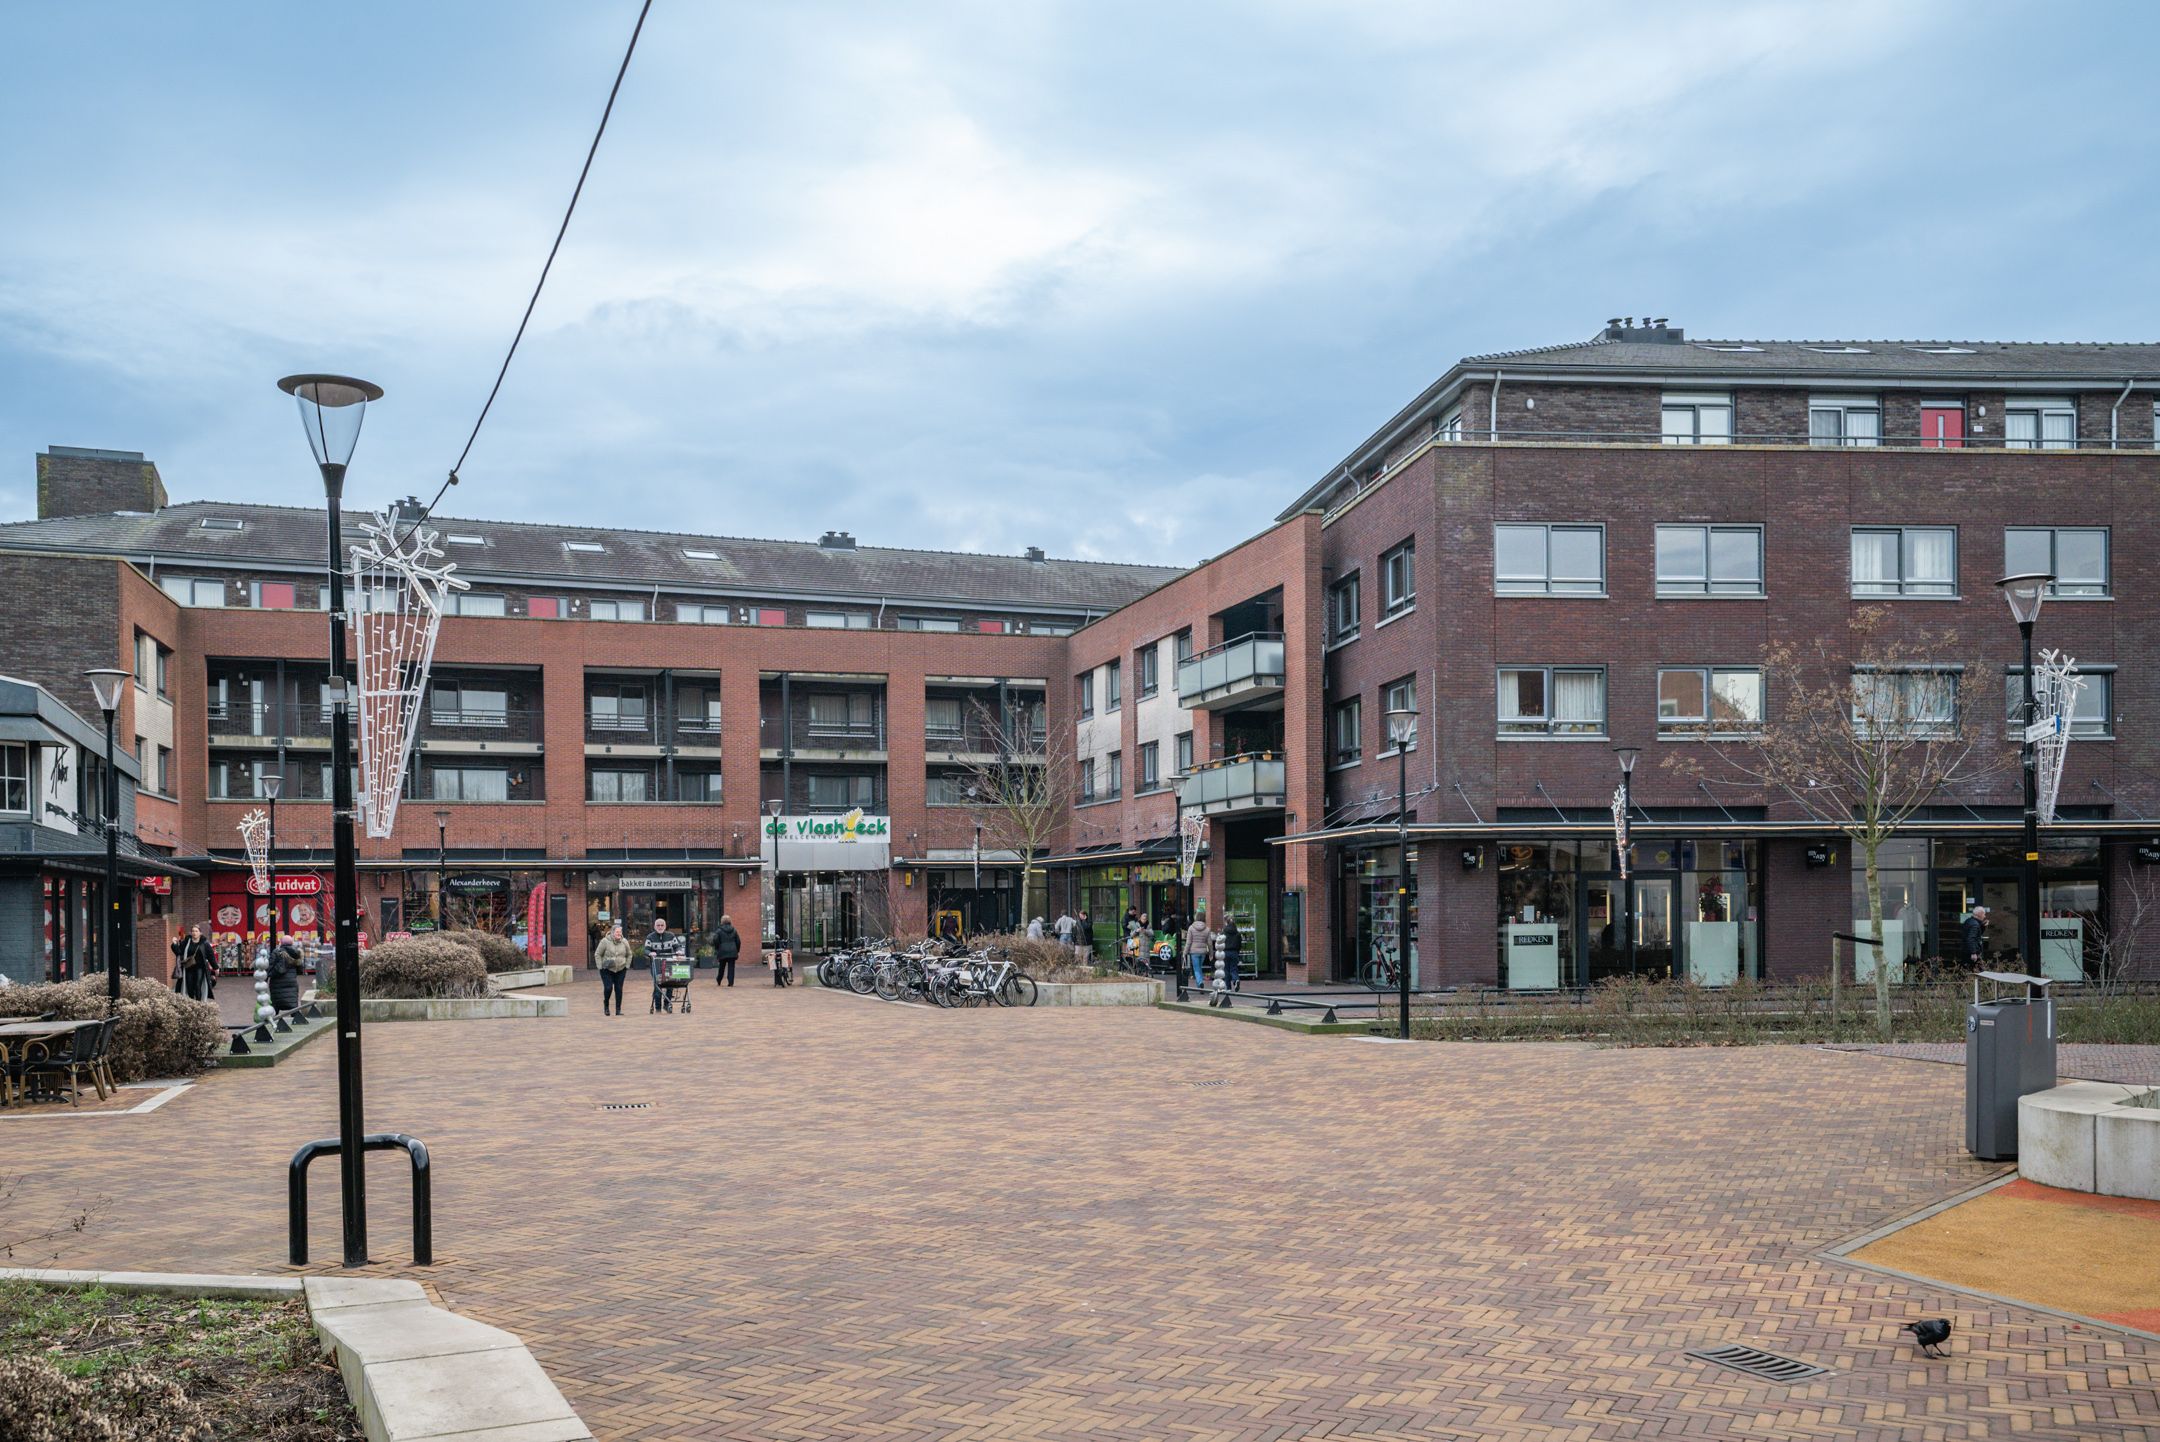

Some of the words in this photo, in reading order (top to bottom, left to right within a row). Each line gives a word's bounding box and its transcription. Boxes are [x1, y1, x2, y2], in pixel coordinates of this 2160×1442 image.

[766, 819, 787, 835] de
[1141, 864, 1164, 882] PLUS
[270, 879, 317, 891] ruidvat
[450, 879, 501, 887] Alexanderhoeve
[2046, 930, 2075, 938] REDKEN
